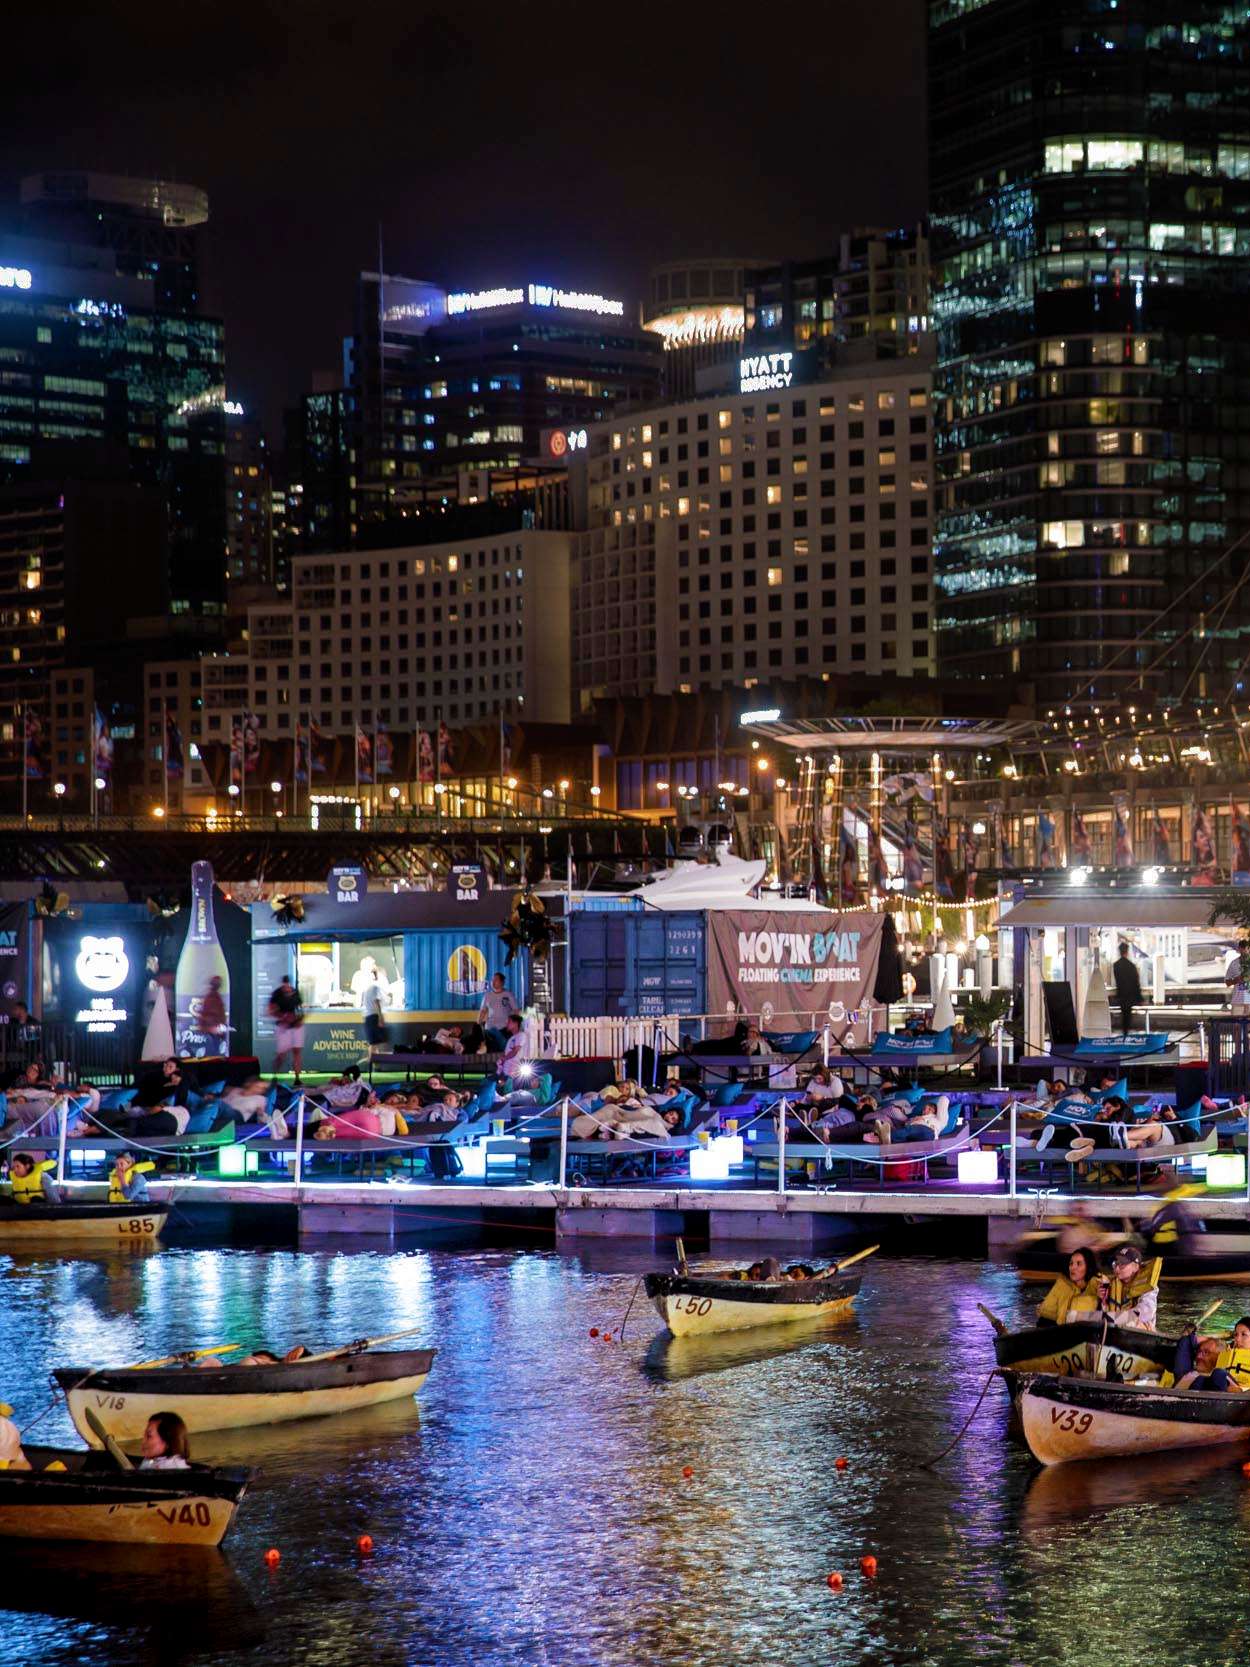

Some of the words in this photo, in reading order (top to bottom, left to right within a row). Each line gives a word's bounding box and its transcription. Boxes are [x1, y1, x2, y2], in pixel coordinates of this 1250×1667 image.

[740, 353, 792, 378] HYATT
[337, 891, 358, 902] BAR
[456, 889, 478, 900] BAR
[738, 932, 811, 965] MOV'IN
[738, 968, 779, 982] FLOATING
[814, 968, 860, 982] EXPERIENCE
[329, 1029, 355, 1039] WINE
[119, 1218, 154, 1234] L85
[96, 1395, 125, 1410] V18
[1051, 1407, 1094, 1435] V39
[157, 1502, 210, 1526] V40
